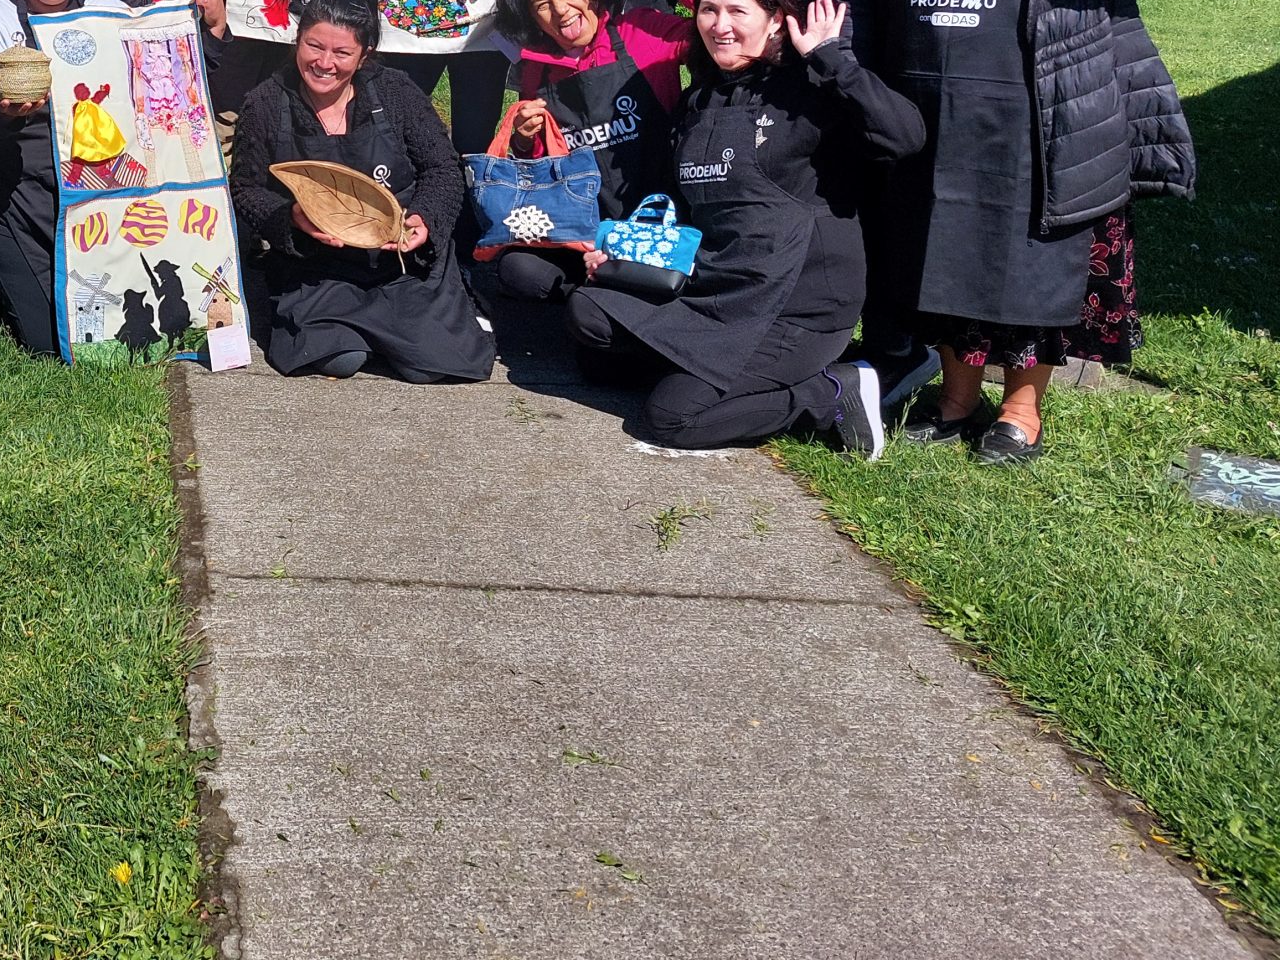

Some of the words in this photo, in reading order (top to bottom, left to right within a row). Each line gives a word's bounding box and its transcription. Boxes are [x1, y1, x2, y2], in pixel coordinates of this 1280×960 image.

[934, 14, 977, 26] TODAS
[563, 115, 636, 151] RODEMU
[679, 163, 728, 180] PRODEMU
